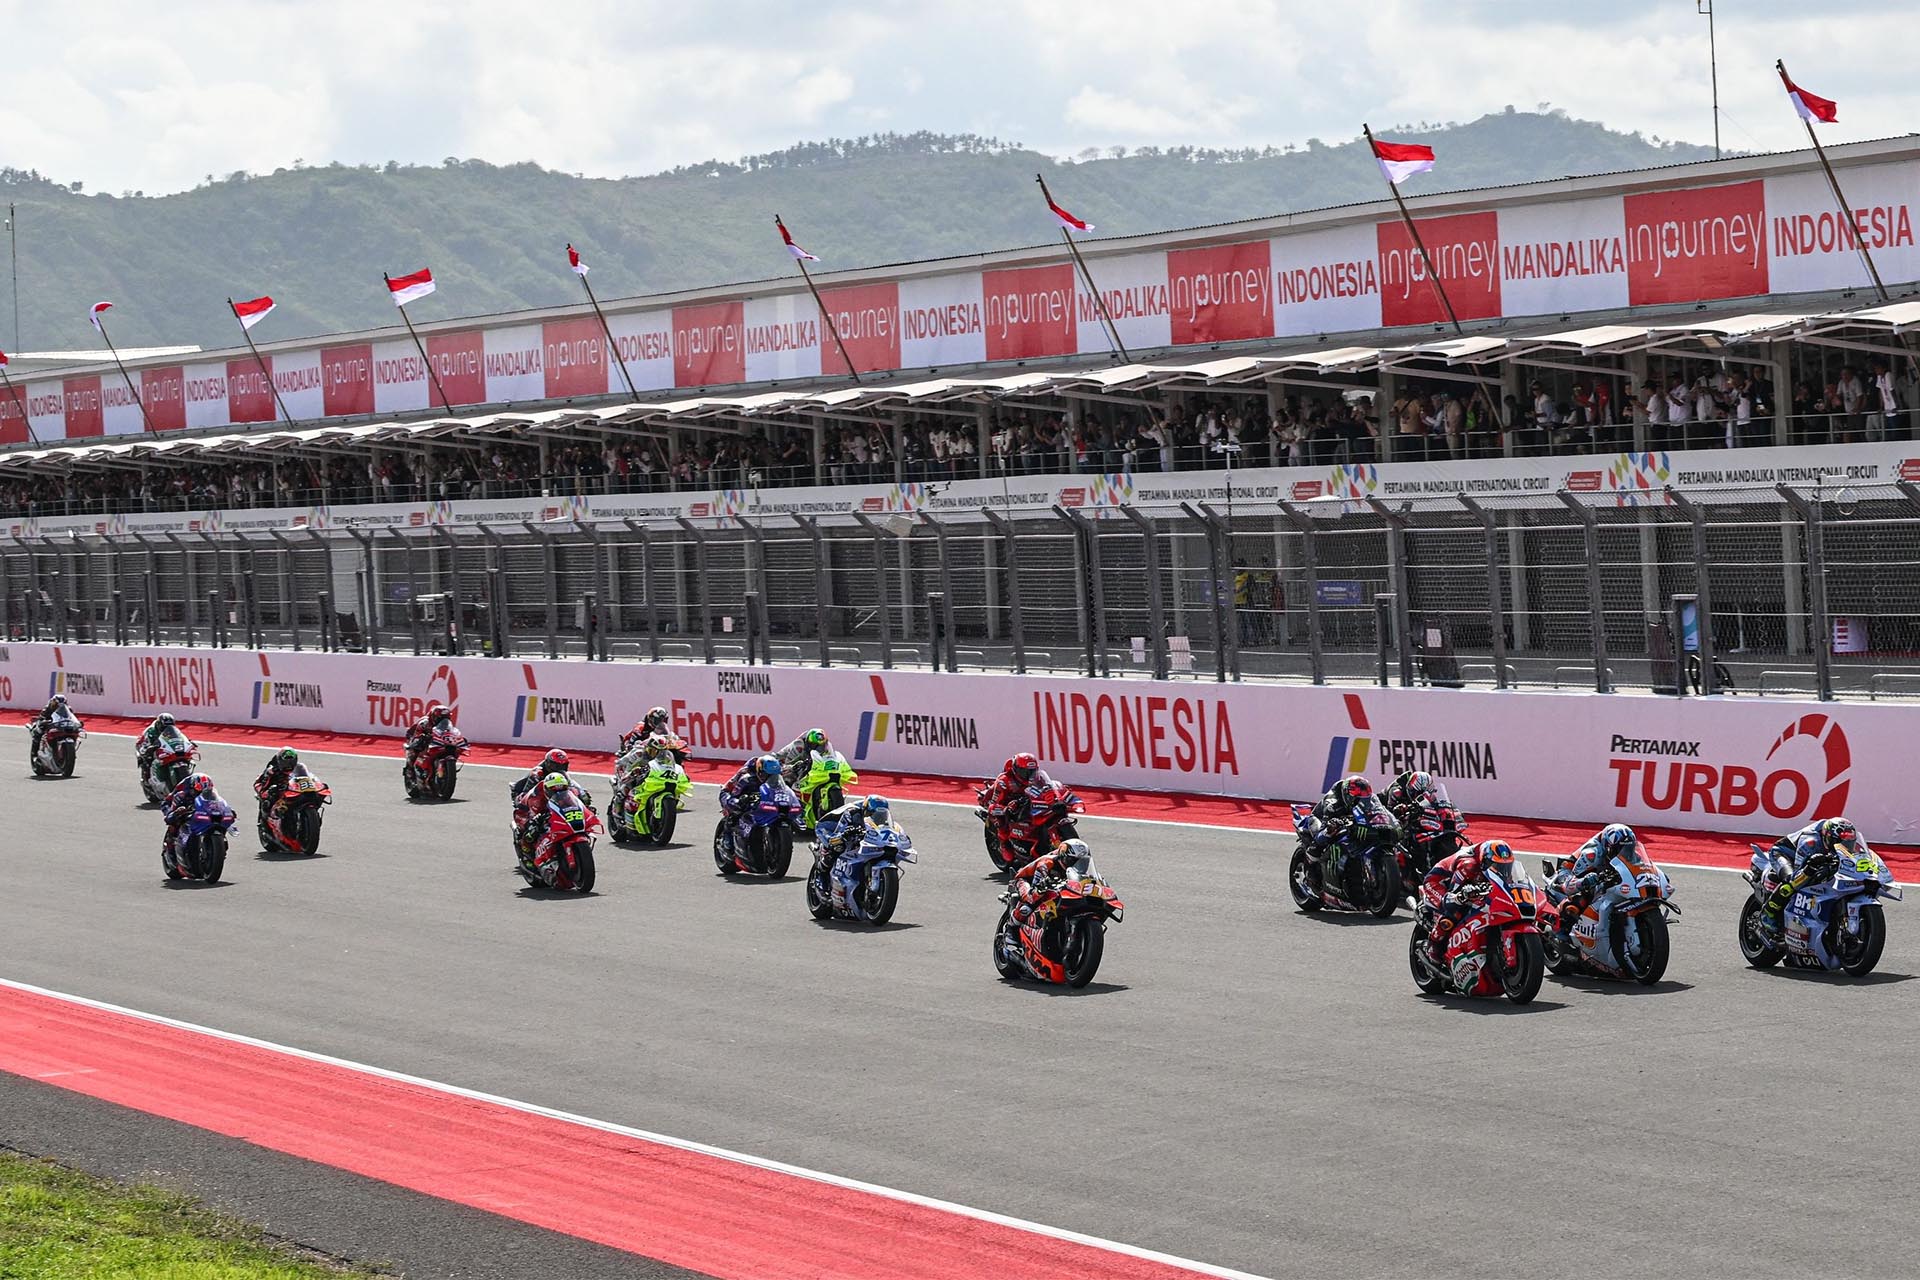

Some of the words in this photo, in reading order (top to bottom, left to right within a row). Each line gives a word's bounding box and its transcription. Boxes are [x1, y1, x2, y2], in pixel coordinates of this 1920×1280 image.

[186, 376, 227, 402] INDONESIA
[274, 366, 321, 393] MANDALIKA
[376, 356, 425, 384] INDONESIA
[486, 348, 542, 378] MANDALIKA
[612, 331, 671, 364] INDONESIA
[747, 320, 817, 354] MANDALIKA
[904, 303, 982, 340] INDONESIA
[1079, 284, 1169, 322] MANDALIKA
[1278, 260, 1378, 305] INDONESIA
[1504, 237, 1625, 281] MANDALIKA
[1774, 204, 1914, 258] INDONESIA
[1384, 480, 1421, 494] PERTAMINA
[1423, 479, 1463, 493] MANDALIKA
[1466, 477, 1521, 492] INTERNATIONAL
[1523, 477, 1549, 490] CIRCUIT
[1678, 470, 1724, 485] PERTAMINA
[1725, 468, 1775, 483] MANDALIKA
[1777, 466, 1845, 482] INTERNATIONAL
[1846, 465, 1878, 480] CIRCUIT
[1138, 489, 1170, 501] PERTAMINA
[1172, 489, 1205, 500] MANDALIKA
[1255, 486, 1278, 498] CIRCUIT
[66, 672, 105, 696] PERTAMINA
[129, 656, 219, 707] INDONESIA
[366, 680, 402, 693] PERTAMAX
[718, 671, 773, 695] PERTAMINA
[274, 682, 324, 709] PERTAMINA
[542, 697, 606, 727] PERTAMINA
[671, 699, 775, 753] Enduro
[895, 713, 980, 750] PERTAMINA
[1034, 691, 1239, 776] INDONESIA
[1611, 734, 1700, 758] PERTAMAX
[1379, 739, 1497, 780] PERTAMINA
[1609, 759, 1810, 820] TURBO
[564, 810, 584, 823] 36
[1510, 888, 1535, 904] 10
